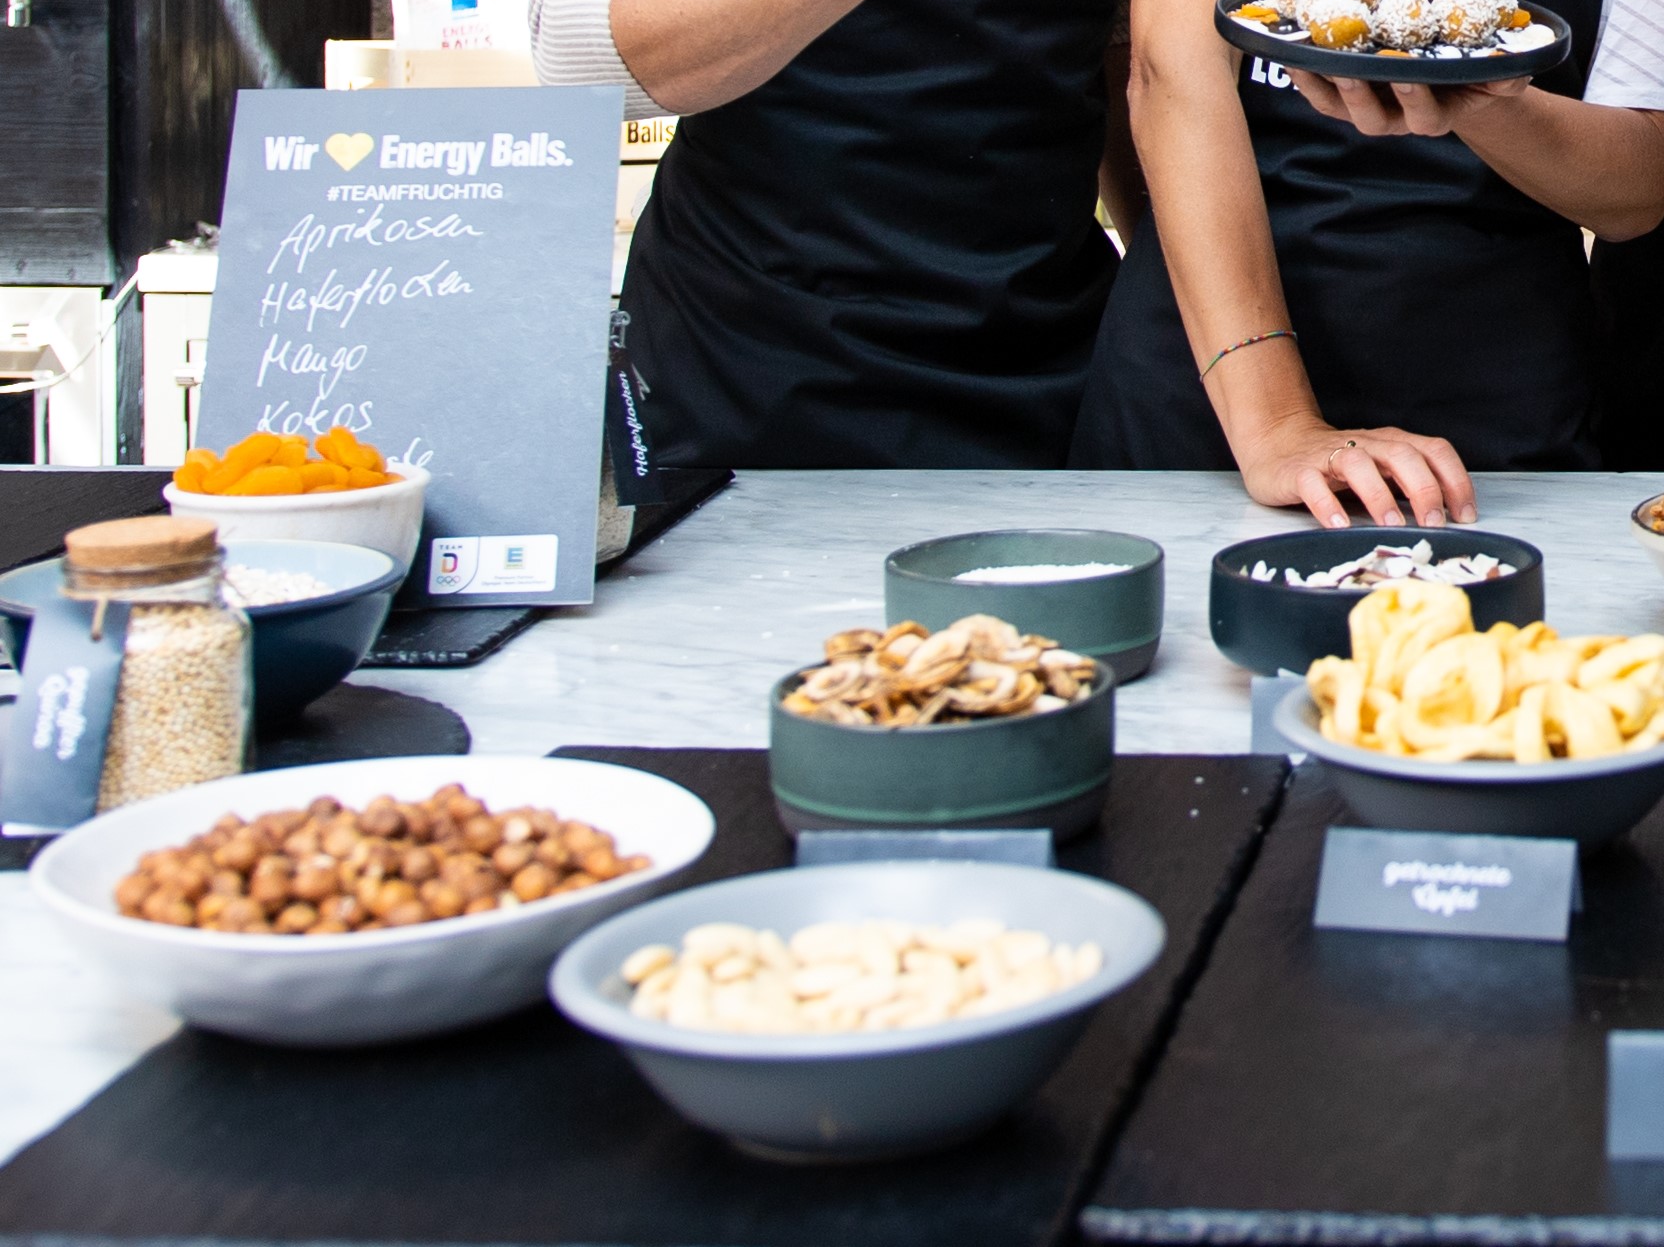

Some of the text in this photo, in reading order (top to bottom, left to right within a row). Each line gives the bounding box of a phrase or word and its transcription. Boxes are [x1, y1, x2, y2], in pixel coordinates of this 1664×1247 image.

[626, 120, 676, 144] Balls
[264, 132, 574, 176] Wir Energy Balls.
[327, 182, 503, 202] #TEAMFRUCHTIG
[256, 397, 373, 434] Kokos
[618, 370, 650, 477] Haferflocken
